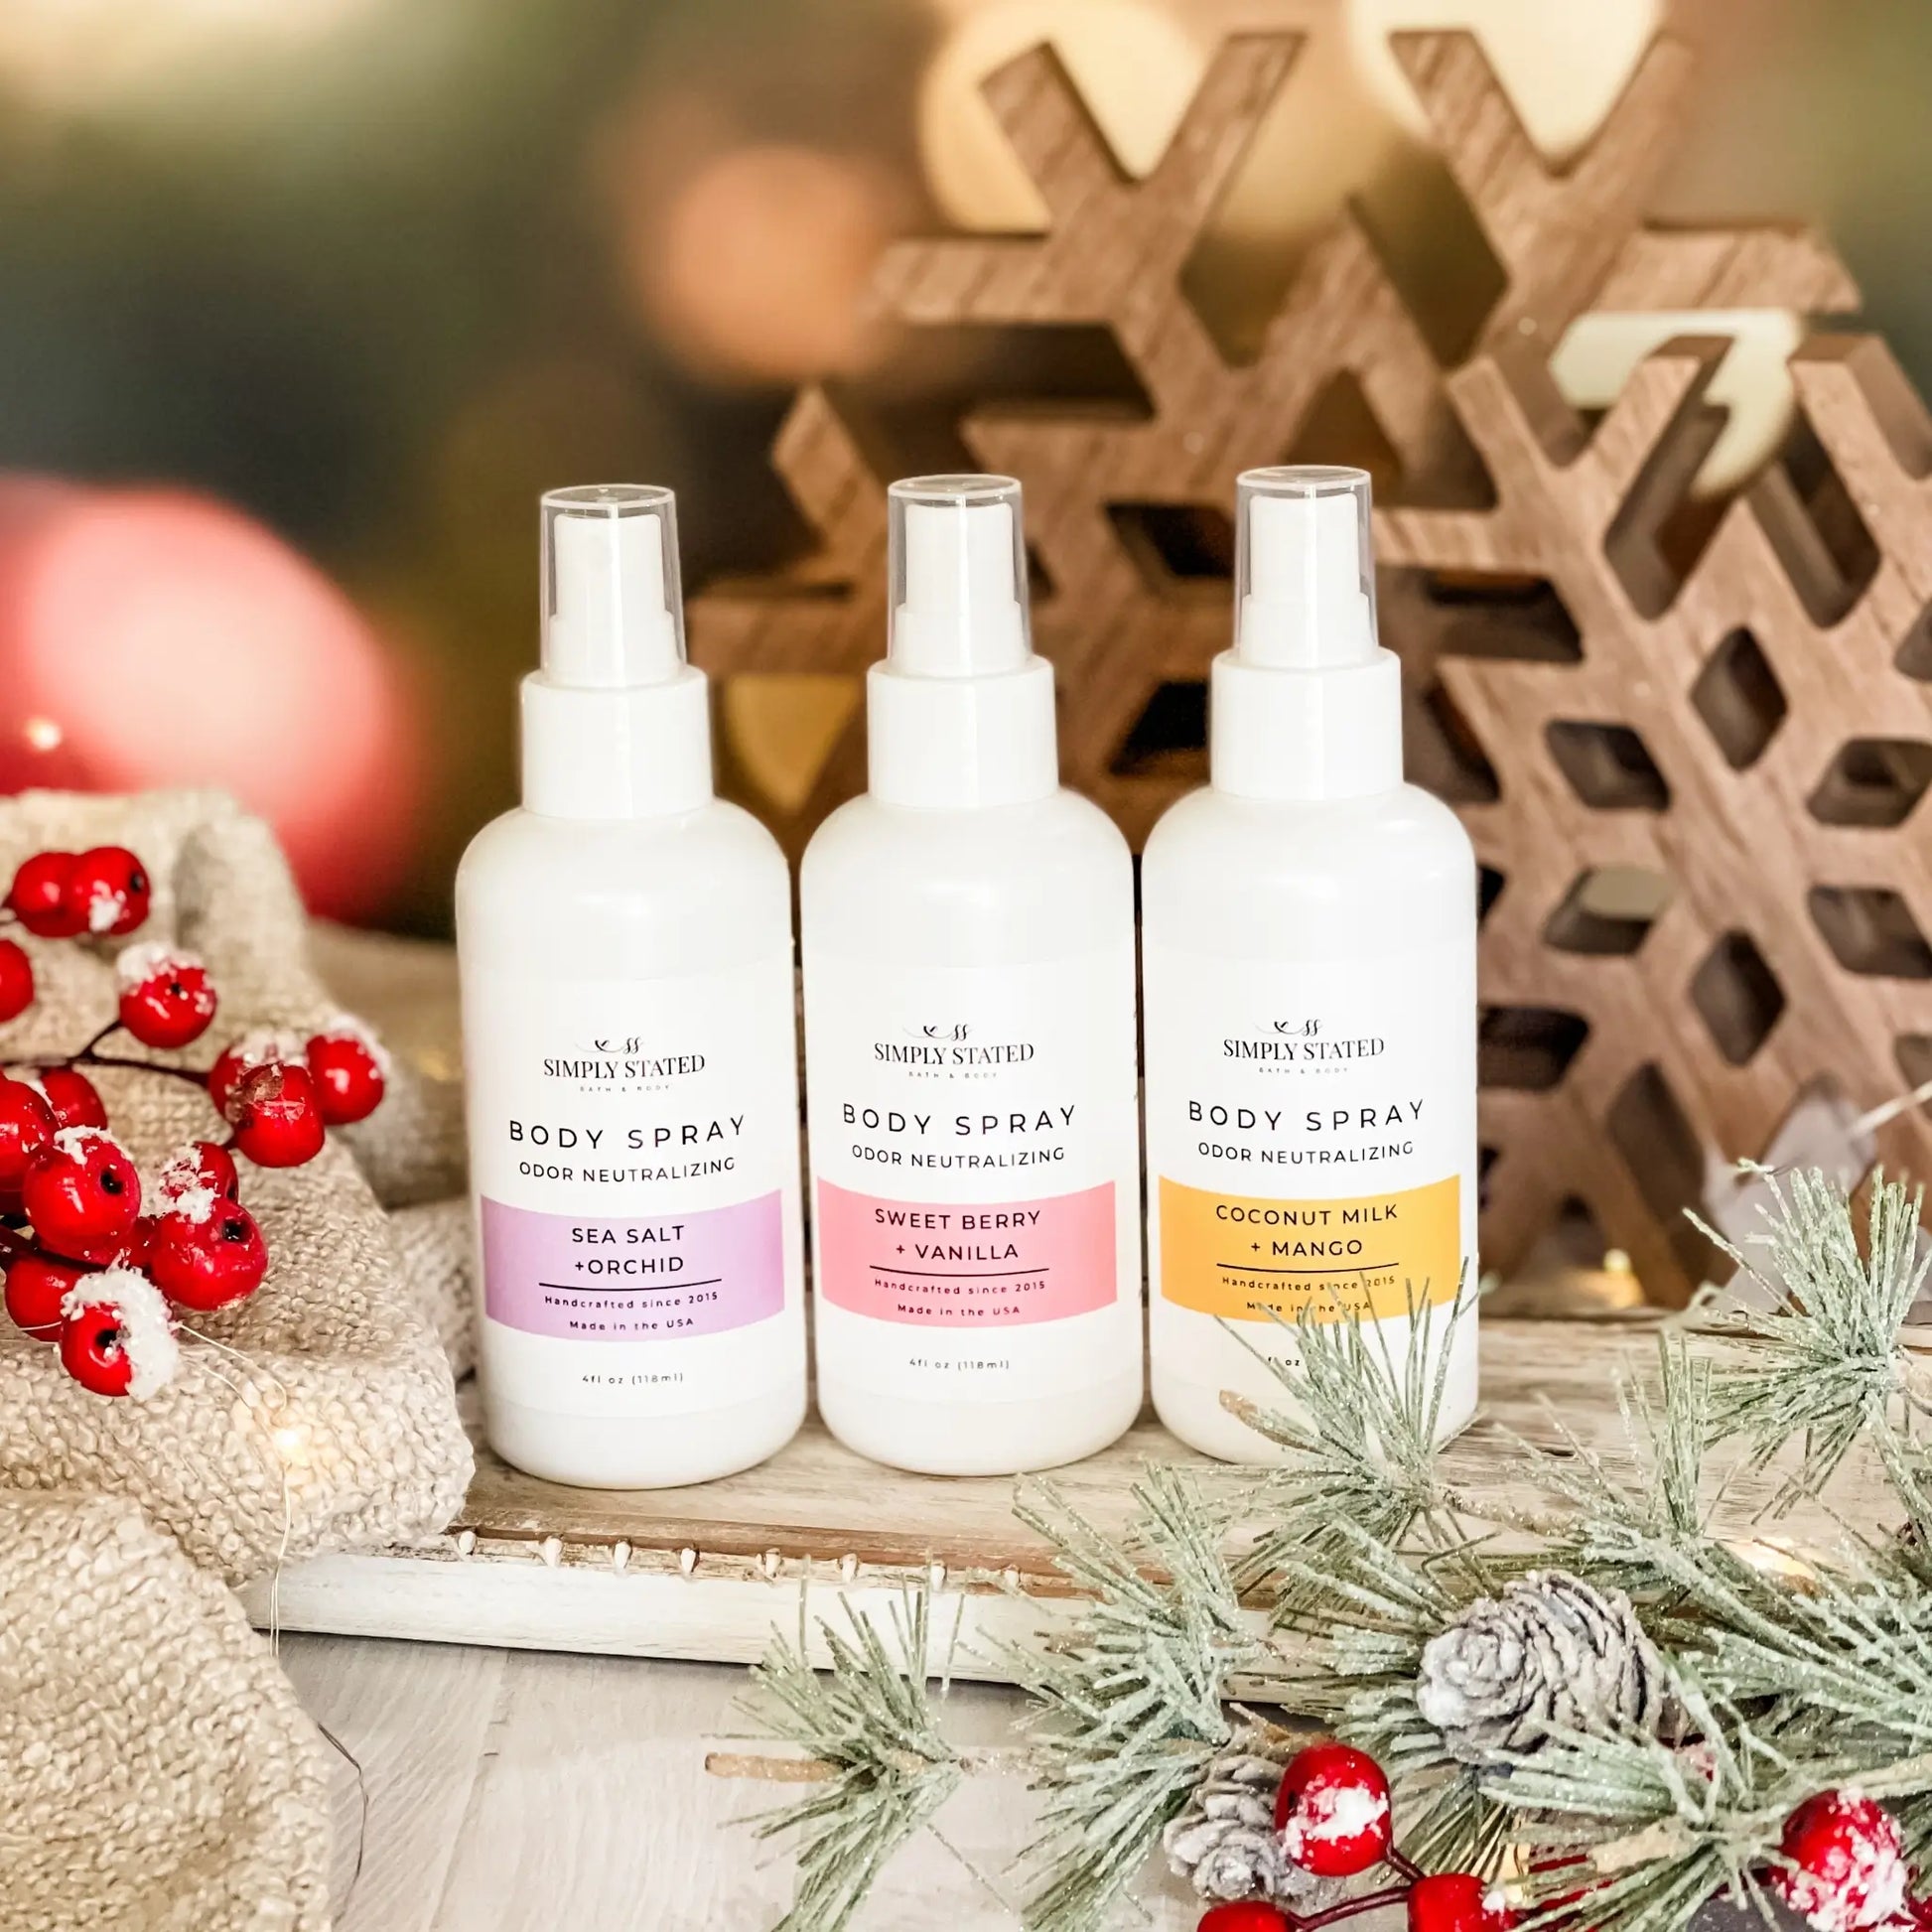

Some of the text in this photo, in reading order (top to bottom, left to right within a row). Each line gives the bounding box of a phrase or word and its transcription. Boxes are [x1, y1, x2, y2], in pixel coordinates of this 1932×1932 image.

[875, 1043, 1034, 1064] SIMPLY STATED
[1224, 1038, 1384, 1060] SIMPLY STATED
[544, 1055, 705, 1078] SIMPLY STATED
[844, 1103, 1074, 1135] BODY SPRAY
[1189, 1100, 1423, 1131] BODY SPRAY
[510, 1115, 743, 1149] BODY SPRAY
[853, 1145, 1063, 1168] ODOR NEUTRALIZING
[1198, 1142, 1413, 1164] ODOR NEUTRALIZING
[520, 1158, 734, 1182] ODOR NEUTRALIZING
[876, 1208, 1039, 1229] SWEET BERRY
[1216, 1204, 1397, 1225] COCONUT MILK
[572, 1225, 684, 1243] SEA SALT
[896, 1244, 1018, 1260] + VANILLA
[1250, 1240, 1362, 1256] + MANGO
[575, 1257, 683, 1275] +ORCHID
[875, 1279, 1045, 1296] Handcrafted since 2015
[1222, 1277, 1311, 1291] Handcrafted
[1318, 1281, 1359, 1292] snce
[545, 1291, 718, 1309] Handcrafted since 2015
[897, 1303, 1021, 1317] Made in the USA
[569, 1317, 694, 1331] Made in the USA
[908, 1358, 1010, 1371] 4fl oz (118ml)
[582, 1375, 601, 1384] 4fl
[631, 1372, 684, 1386] (118ml)
